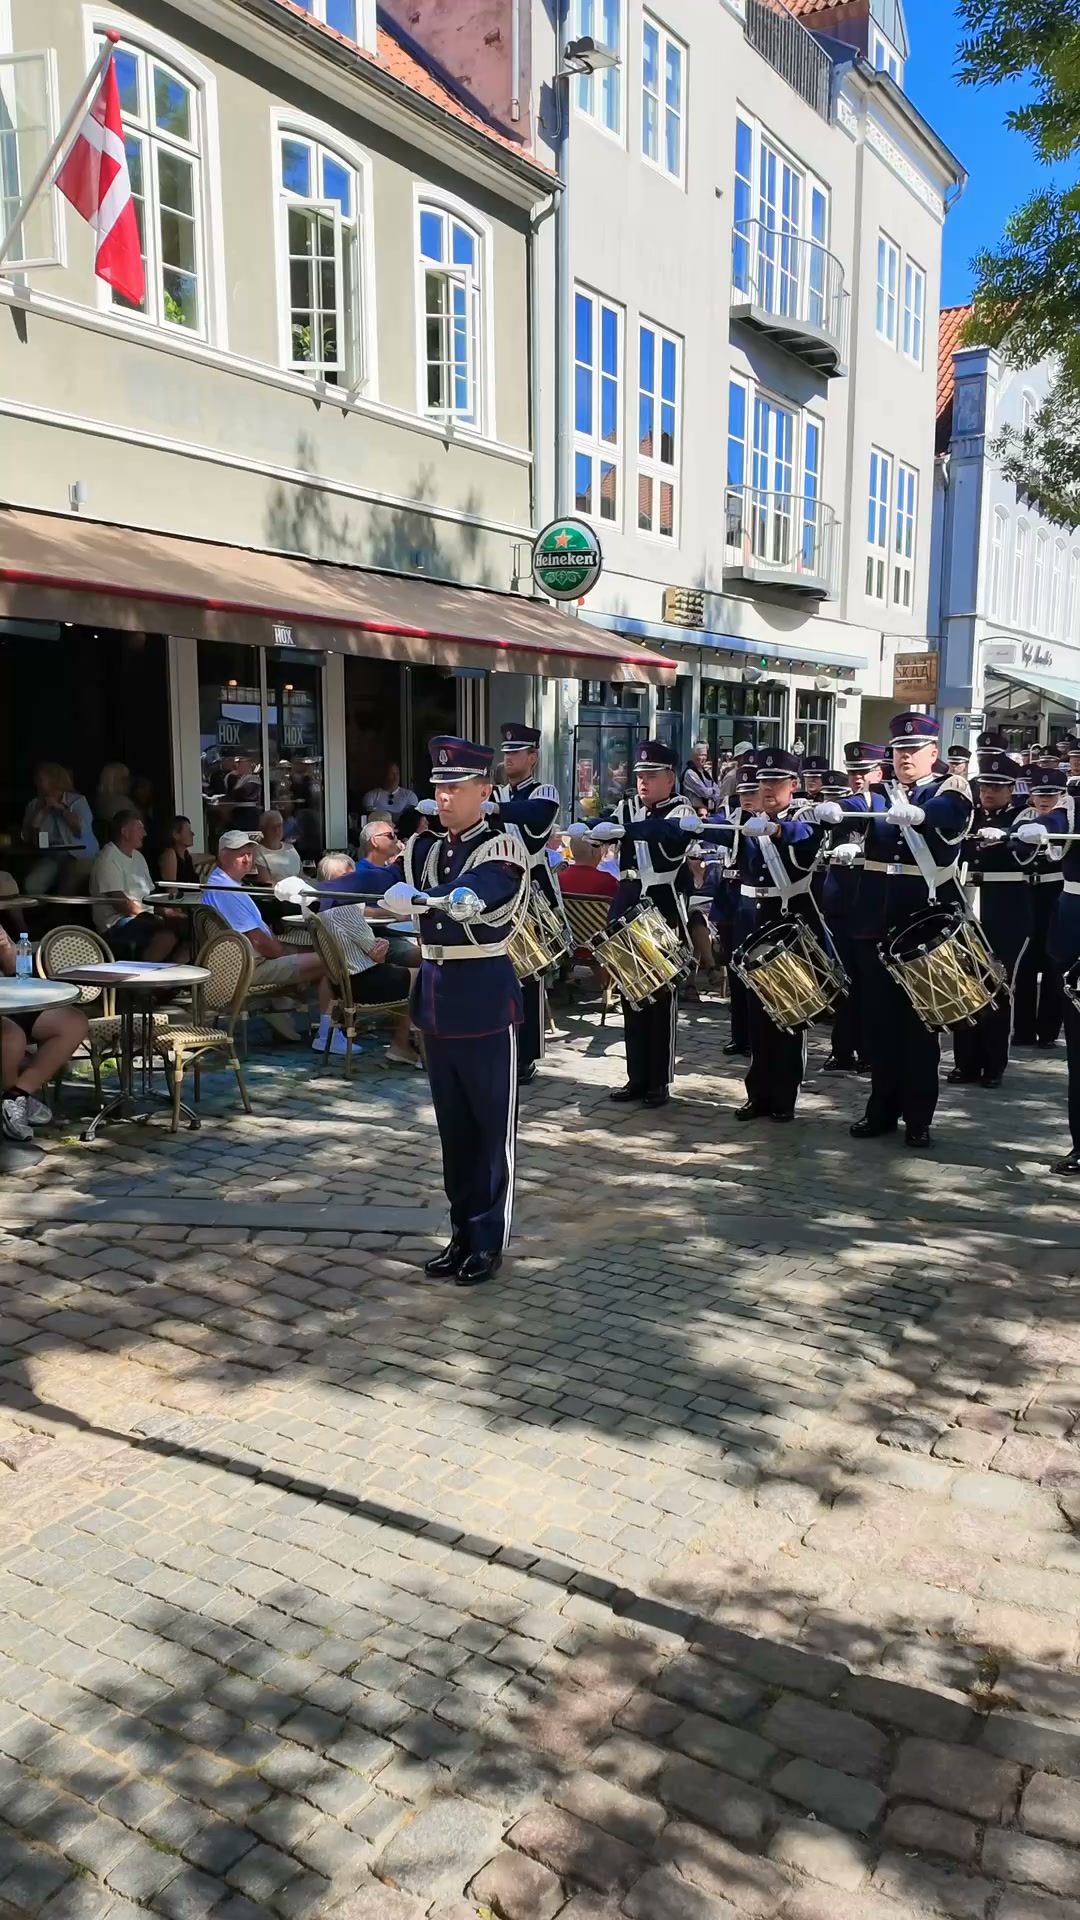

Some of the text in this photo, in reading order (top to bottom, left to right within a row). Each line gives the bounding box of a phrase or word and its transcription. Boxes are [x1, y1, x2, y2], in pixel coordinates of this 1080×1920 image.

[535, 552, 594, 567] Heineken
[274, 627, 295, 645] HOX
[218, 722, 241, 744] HOX
[283, 725, 304, 745] HOX
